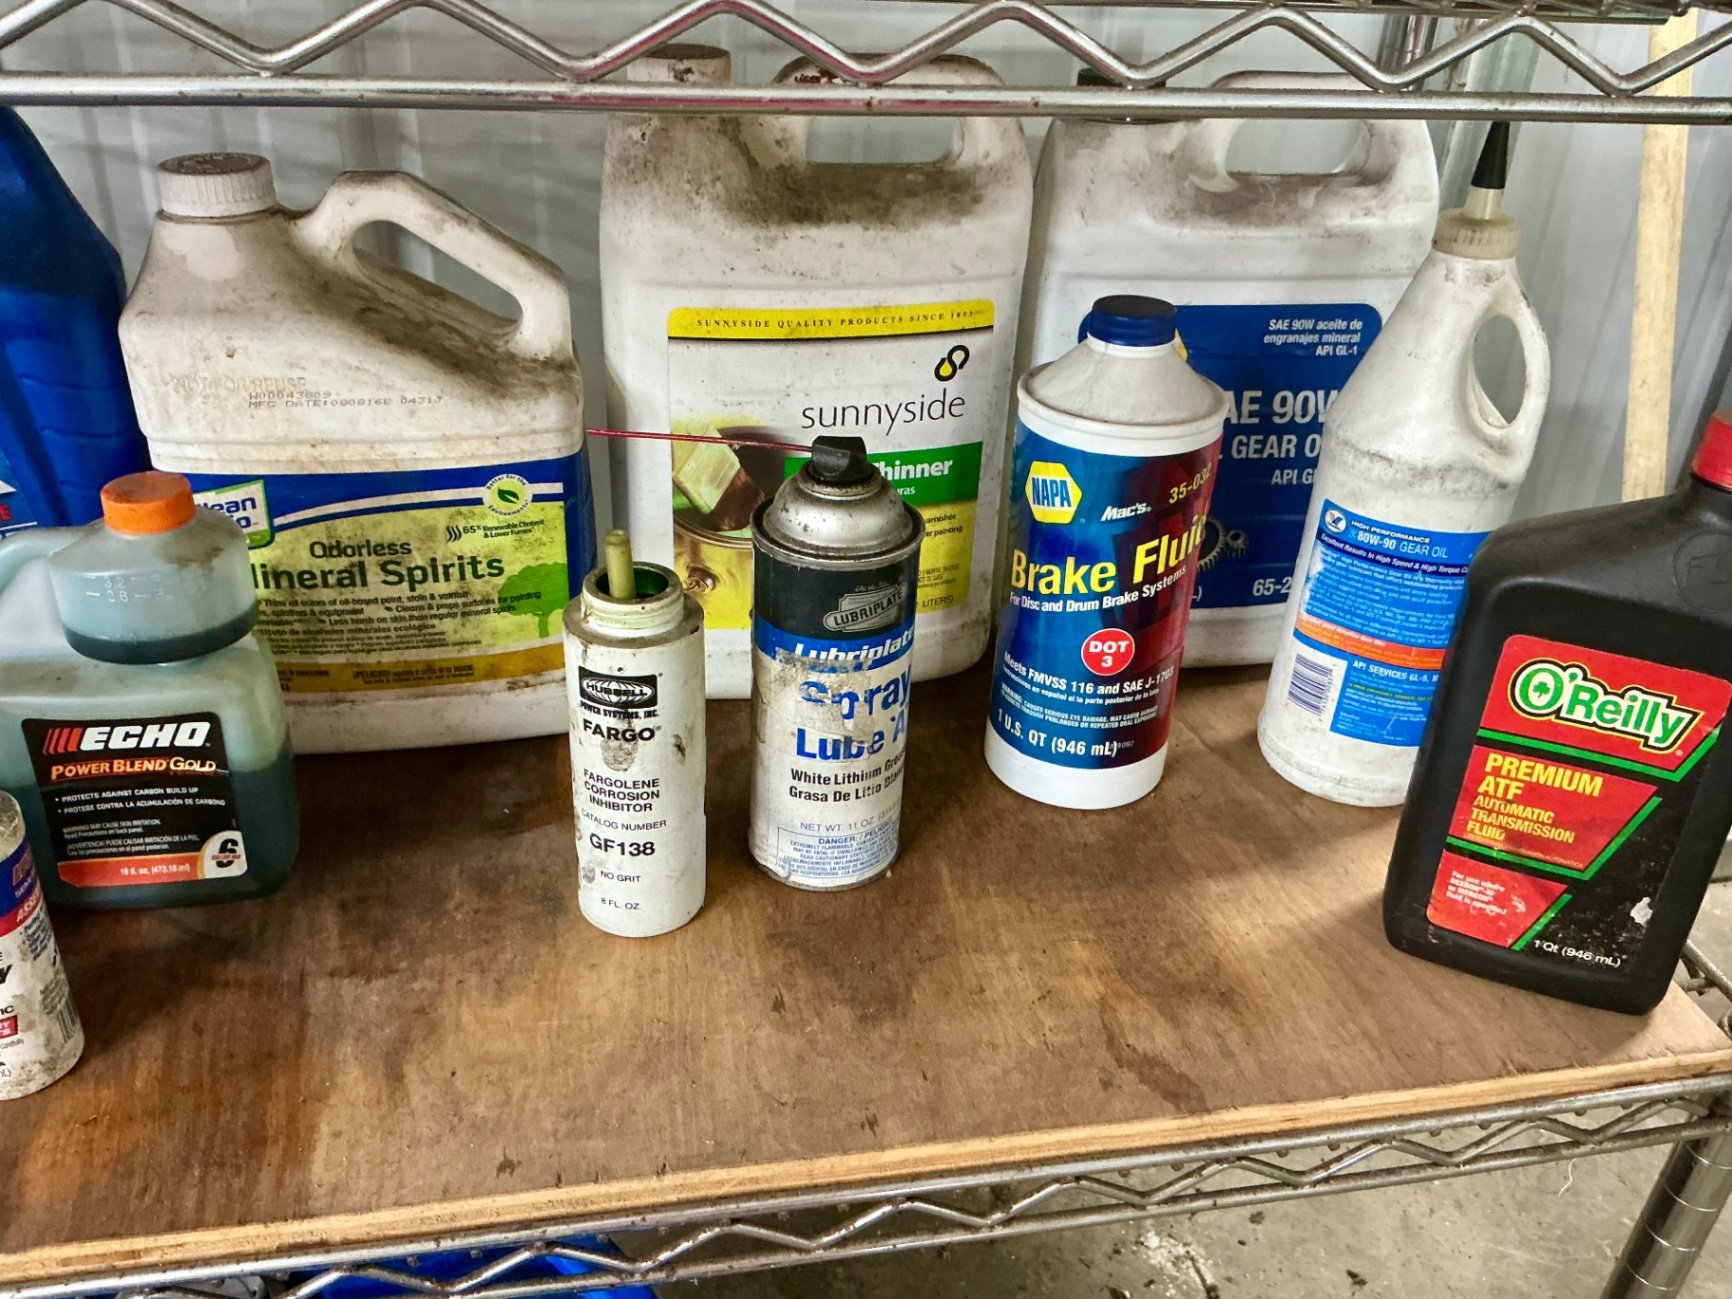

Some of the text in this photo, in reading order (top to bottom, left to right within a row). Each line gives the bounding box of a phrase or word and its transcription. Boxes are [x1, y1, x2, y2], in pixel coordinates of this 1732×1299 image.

[697, 312, 946, 328] SUNNYSIDE QUALITY PRODUCTS SINCE
[1268, 318, 1362, 331] SAE 90W aceite de
[1263, 332, 1360, 350] engranajes mineral
[1315, 345, 1357, 360] API GL-1
[248, 400, 276, 409] MFG
[801, 388, 967, 436] sunnyside
[1224, 390, 1263, 424] AE
[1231, 435, 1297, 460] GEAR
[1271, 468, 1298, 485] API
[1030, 477, 1072, 509] NAPA
[1100, 503, 1148, 522] Mac's
[483, 523, 519, 534] Renewable
[490, 529, 510, 537] Lower
[934, 525, 963, 538] painting
[1351, 520, 1431, 544] HIGH PERFORMANCE
[309, 541, 413, 564] Odorless
[1011, 500, 1209, 595] Brake Fluid
[1357, 530, 1449, 559] 80W-90 GEAR OIL
[1345, 545, 1368, 559] Results
[1376, 554, 1392, 566] High
[1392, 558, 1413, 570] Speed
[1420, 563, 1438, 573] High
[1438, 564, 1460, 576] Torque
[381, 554, 507, 597] Spirits
[265, 599, 287, 608] Thins
[301, 598, 327, 608] colors
[339, 597, 379, 607] oil-based
[407, 593, 428, 603] stain
[1010, 591, 1021, 604] For
[1021, 596, 1041, 612] Disc
[1042, 600, 1063, 612] and
[1065, 599, 1099, 613] Drum
[1102, 589, 1139, 608] Brake
[1141, 566, 1187, 598] Systems
[318, 606, 365, 619] equipment
[395, 602, 426, 614] Cleans
[461, 598, 496, 608] surfaces
[328, 604, 492, 626] Less harsh on skin than regular mineral
[834, 588, 904, 628] LUBRIPLATE
[346, 622, 392, 633] minerales
[393, 619, 437, 632] ecológico
[1088, 640, 1130, 655] DOT
[1003, 650, 1027, 677] Meets
[1028, 670, 1068, 691] FMVSS
[1071, 681, 1094, 694] 116
[1096, 683, 1120, 695] and
[1122, 680, 1143, 694] SAE
[1101, 655, 1114, 668] 3
[1352, 659, 1408, 681] API SERVICES
[586, 682, 648, 698] HUBBELL
[800, 663, 911, 721] Spray
[1104, 695, 1134, 706] posterior
[581, 700, 602, 716] POWER
[643, 709, 660, 720] INC.
[1044, 707, 1069, 721] SERIOUS
[1515, 664, 1692, 747] O'Reilly
[583, 718, 656, 743] FARGO
[998, 708, 1004, 723] 1
[1004, 718, 1024, 740] U.S.
[1028, 730, 1048, 748] QT
[1051, 736, 1087, 757] (946
[1090, 741, 1118, 758] mL)
[1089, 720, 1119, 729] REPEATED
[79, 721, 211, 751] ECHO
[796, 727, 885, 762] Lube
[51, 756, 217, 781] POWER BLEND GOLD
[583, 768, 660, 791] FARGOLENE
[790, 767, 833, 786] White
[834, 766, 882, 786] Lithium
[1484, 752, 1605, 798] PREMIUM
[61, 786, 199, 804] PROTECTS AGAINST CARBON BUILD UP
[584, 780, 660, 801] CORROSION
[789, 782, 881, 803] Grasa De Litio
[1477, 777, 1526, 801] ATF
[96, 801, 125, 811] CONTRA
[136, 797, 184, 808] ACUMULACIÓN
[196, 798, 226, 807] CARBONO
[589, 796, 653, 813] INHIBITOR
[1472, 795, 1556, 824] AUTOMATIC
[581, 808, 668, 832] CATALOG NUMBER
[801, 821, 826, 836] NET
[826, 824, 844, 836] WT
[848, 822, 858, 834] 11
[860, 816, 876, 830] OZ
[1470, 807, 1576, 844] TRANSMISSION
[818, 835, 856, 846] DANGER
[1466, 822, 1506, 842] FLUID
[216, 838, 239, 869] 6
[589, 833, 656, 858] GF138
[600, 870, 642, 883] NO GRIT
[1541, 941, 1622, 968] Qt (946 mL)
